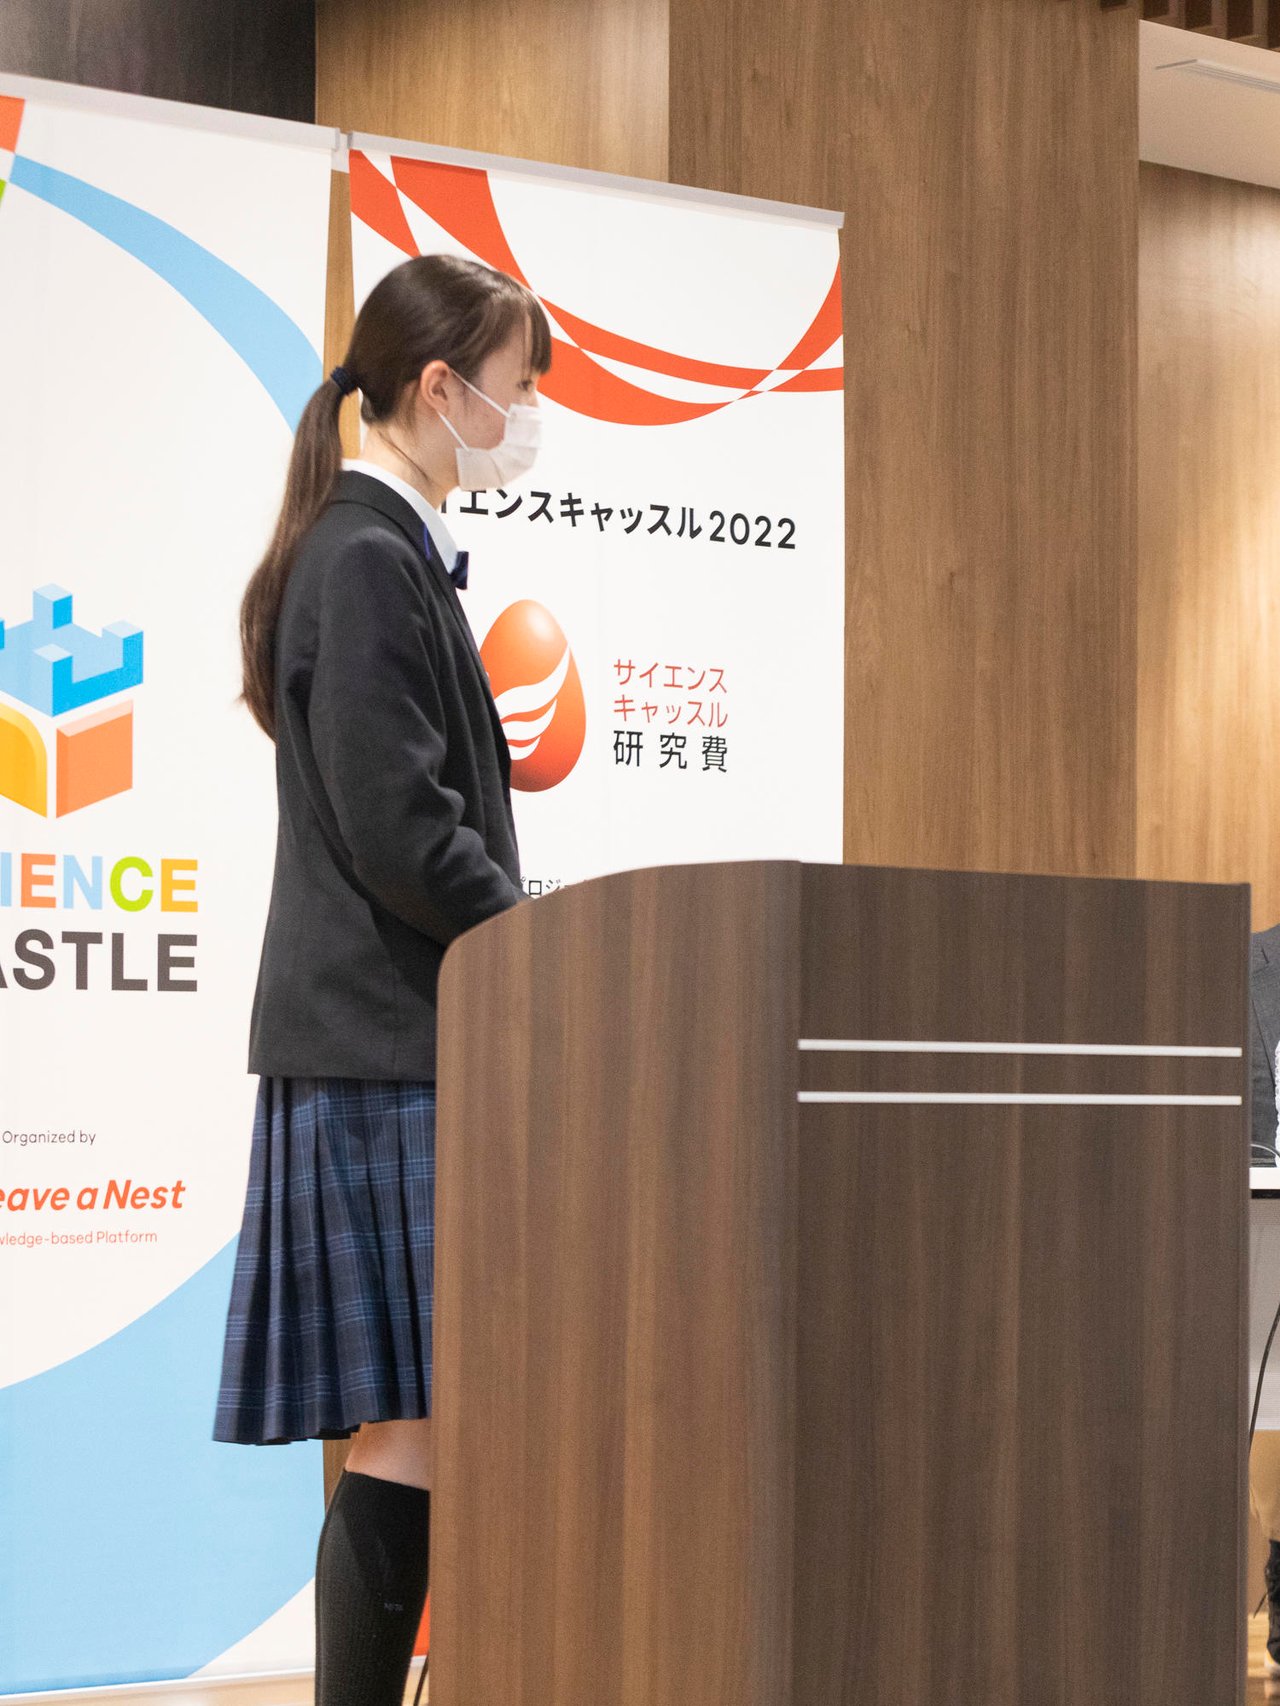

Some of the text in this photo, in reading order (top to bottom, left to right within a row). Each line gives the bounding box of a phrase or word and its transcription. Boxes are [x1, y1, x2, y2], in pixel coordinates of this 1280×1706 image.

[613, 658, 728, 693] サイエンス
[613, 694, 728, 729] キャッスル
[612, 729, 728, 773] 研究費
[0, 928, 198, 993] STLE
[2, 1130, 97, 1147] Organized by
[76, 1187, 99, 1211] a
[103, 1179, 187, 1210] Nest
[96, 1229, 158, 1245] Platform
